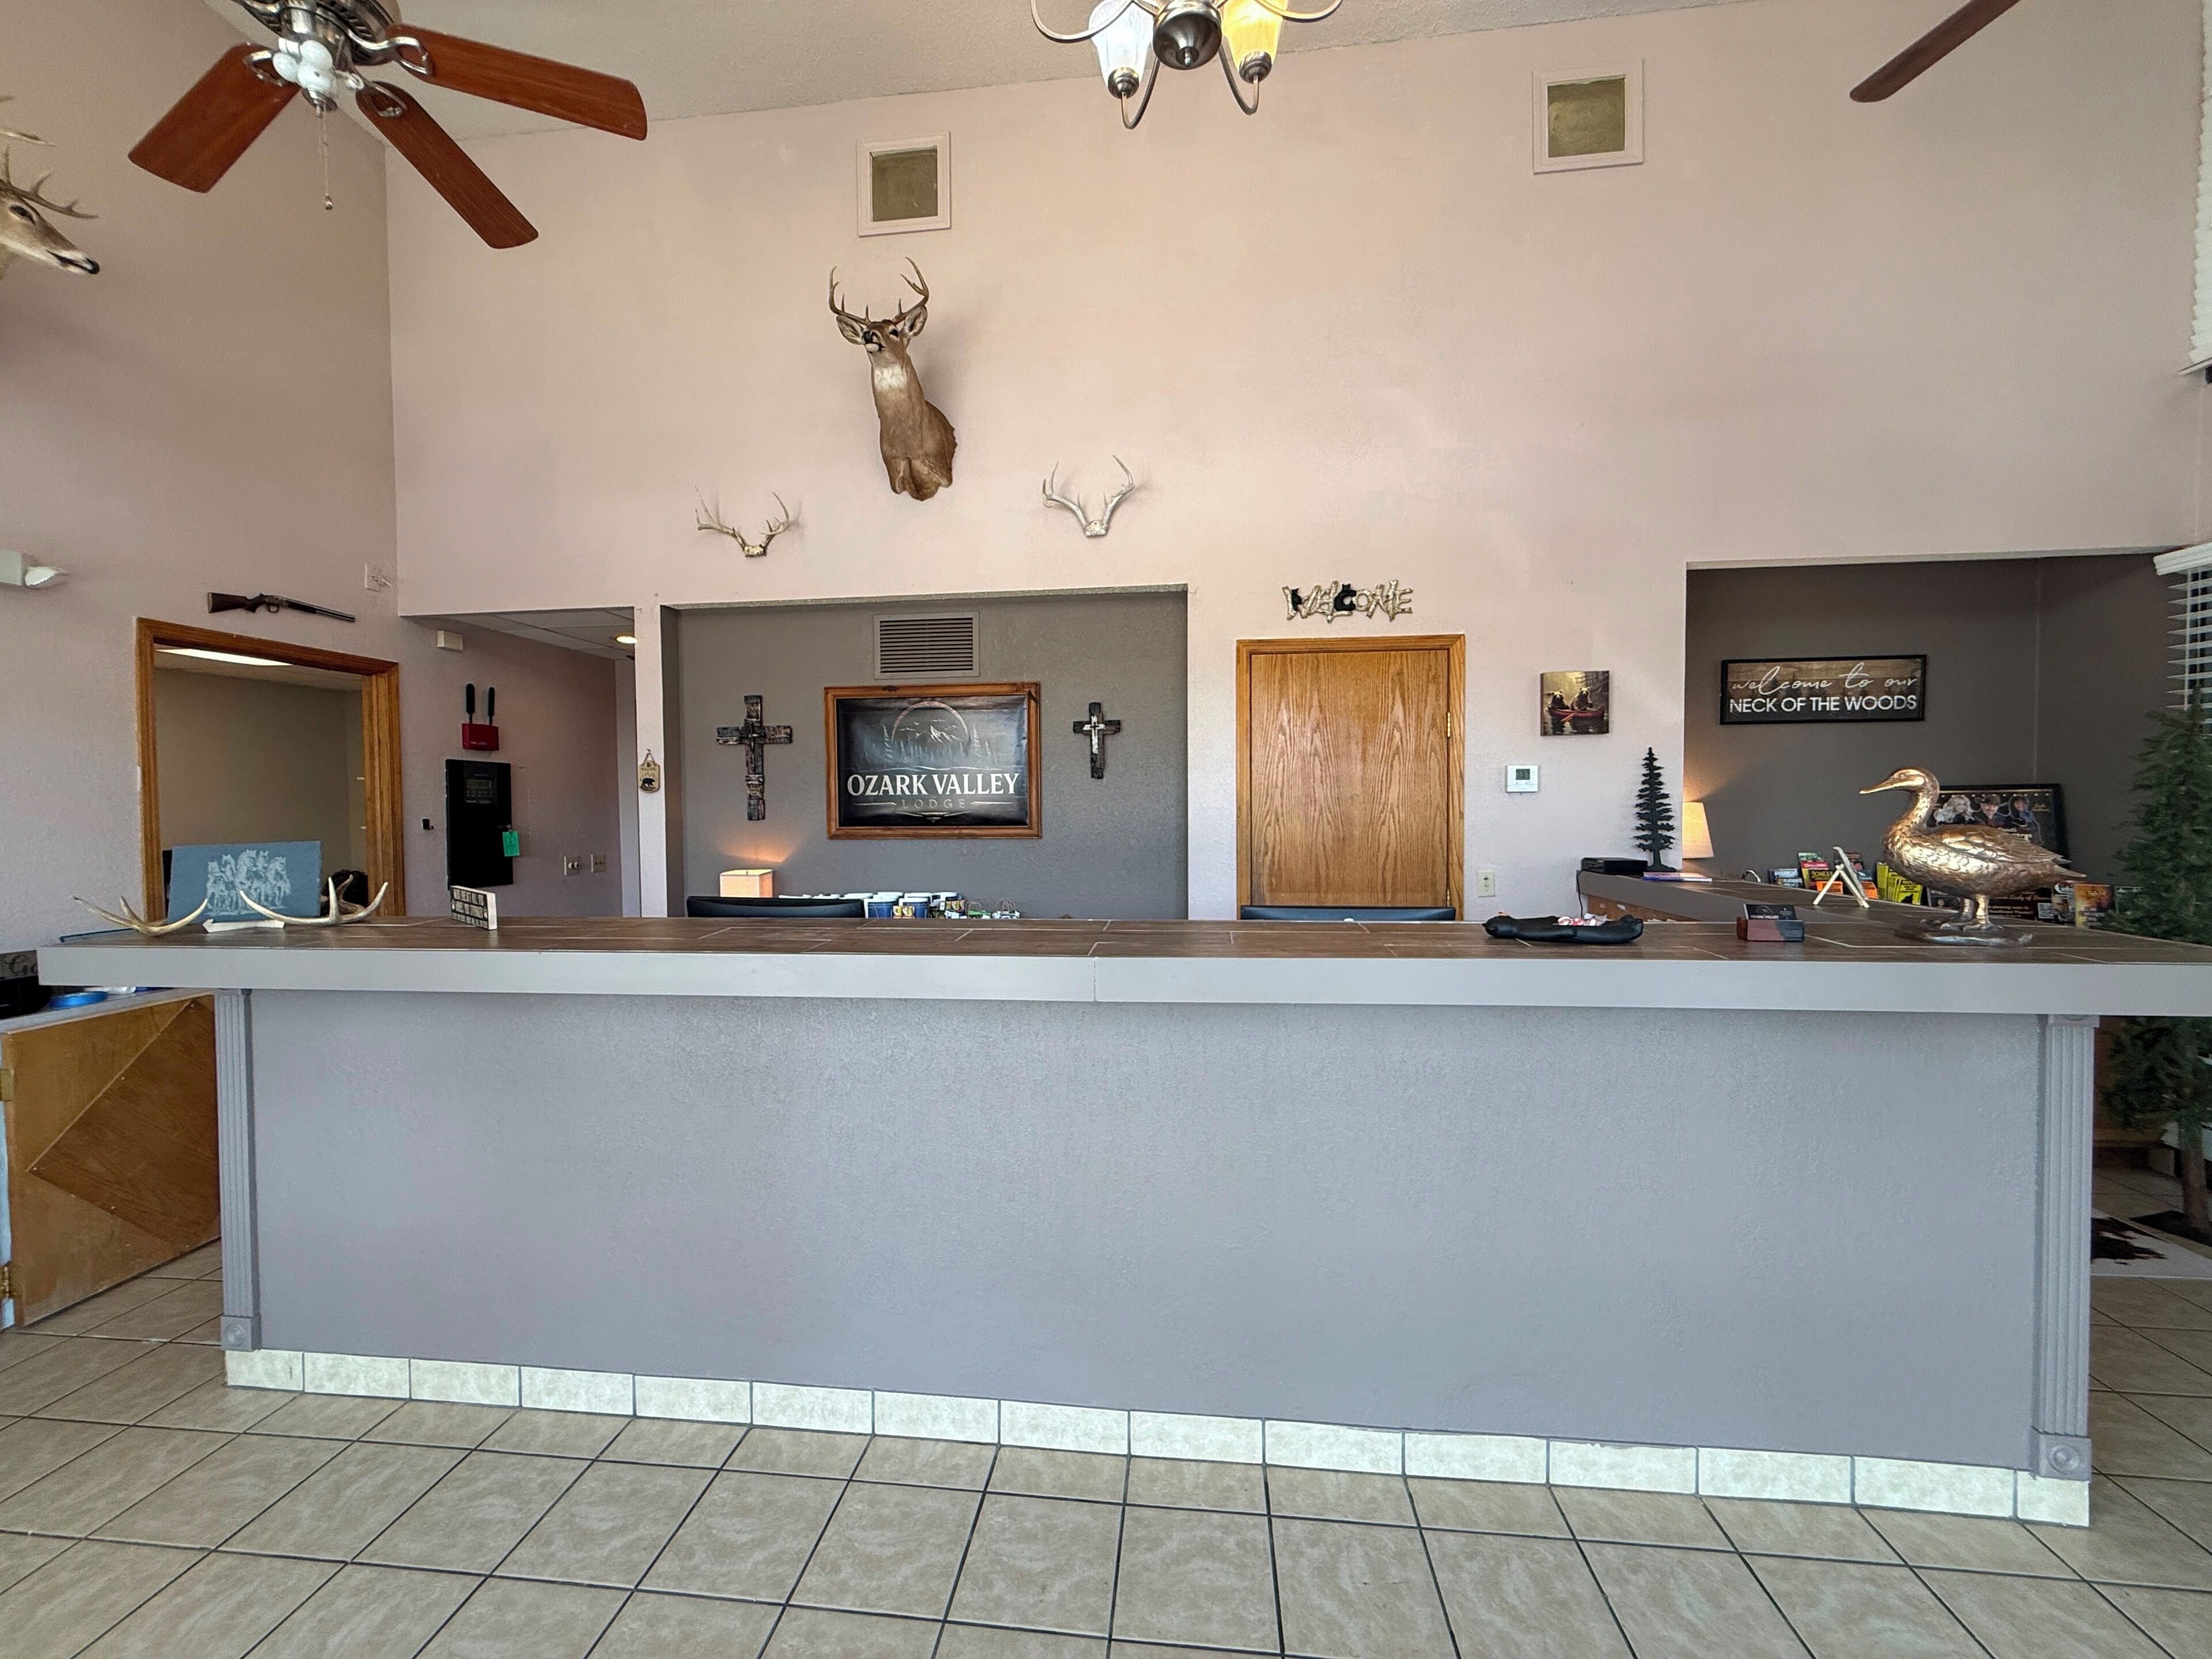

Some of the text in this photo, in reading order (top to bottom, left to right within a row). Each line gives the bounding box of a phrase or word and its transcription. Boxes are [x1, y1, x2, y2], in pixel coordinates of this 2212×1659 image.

[1732, 662, 1917, 695] welcome to our
[1730, 695, 1917, 713] NECK OF THE WOODS
[847, 772, 1020, 796] OZARK VALLEY
[902, 799, 966, 809] LODGE
